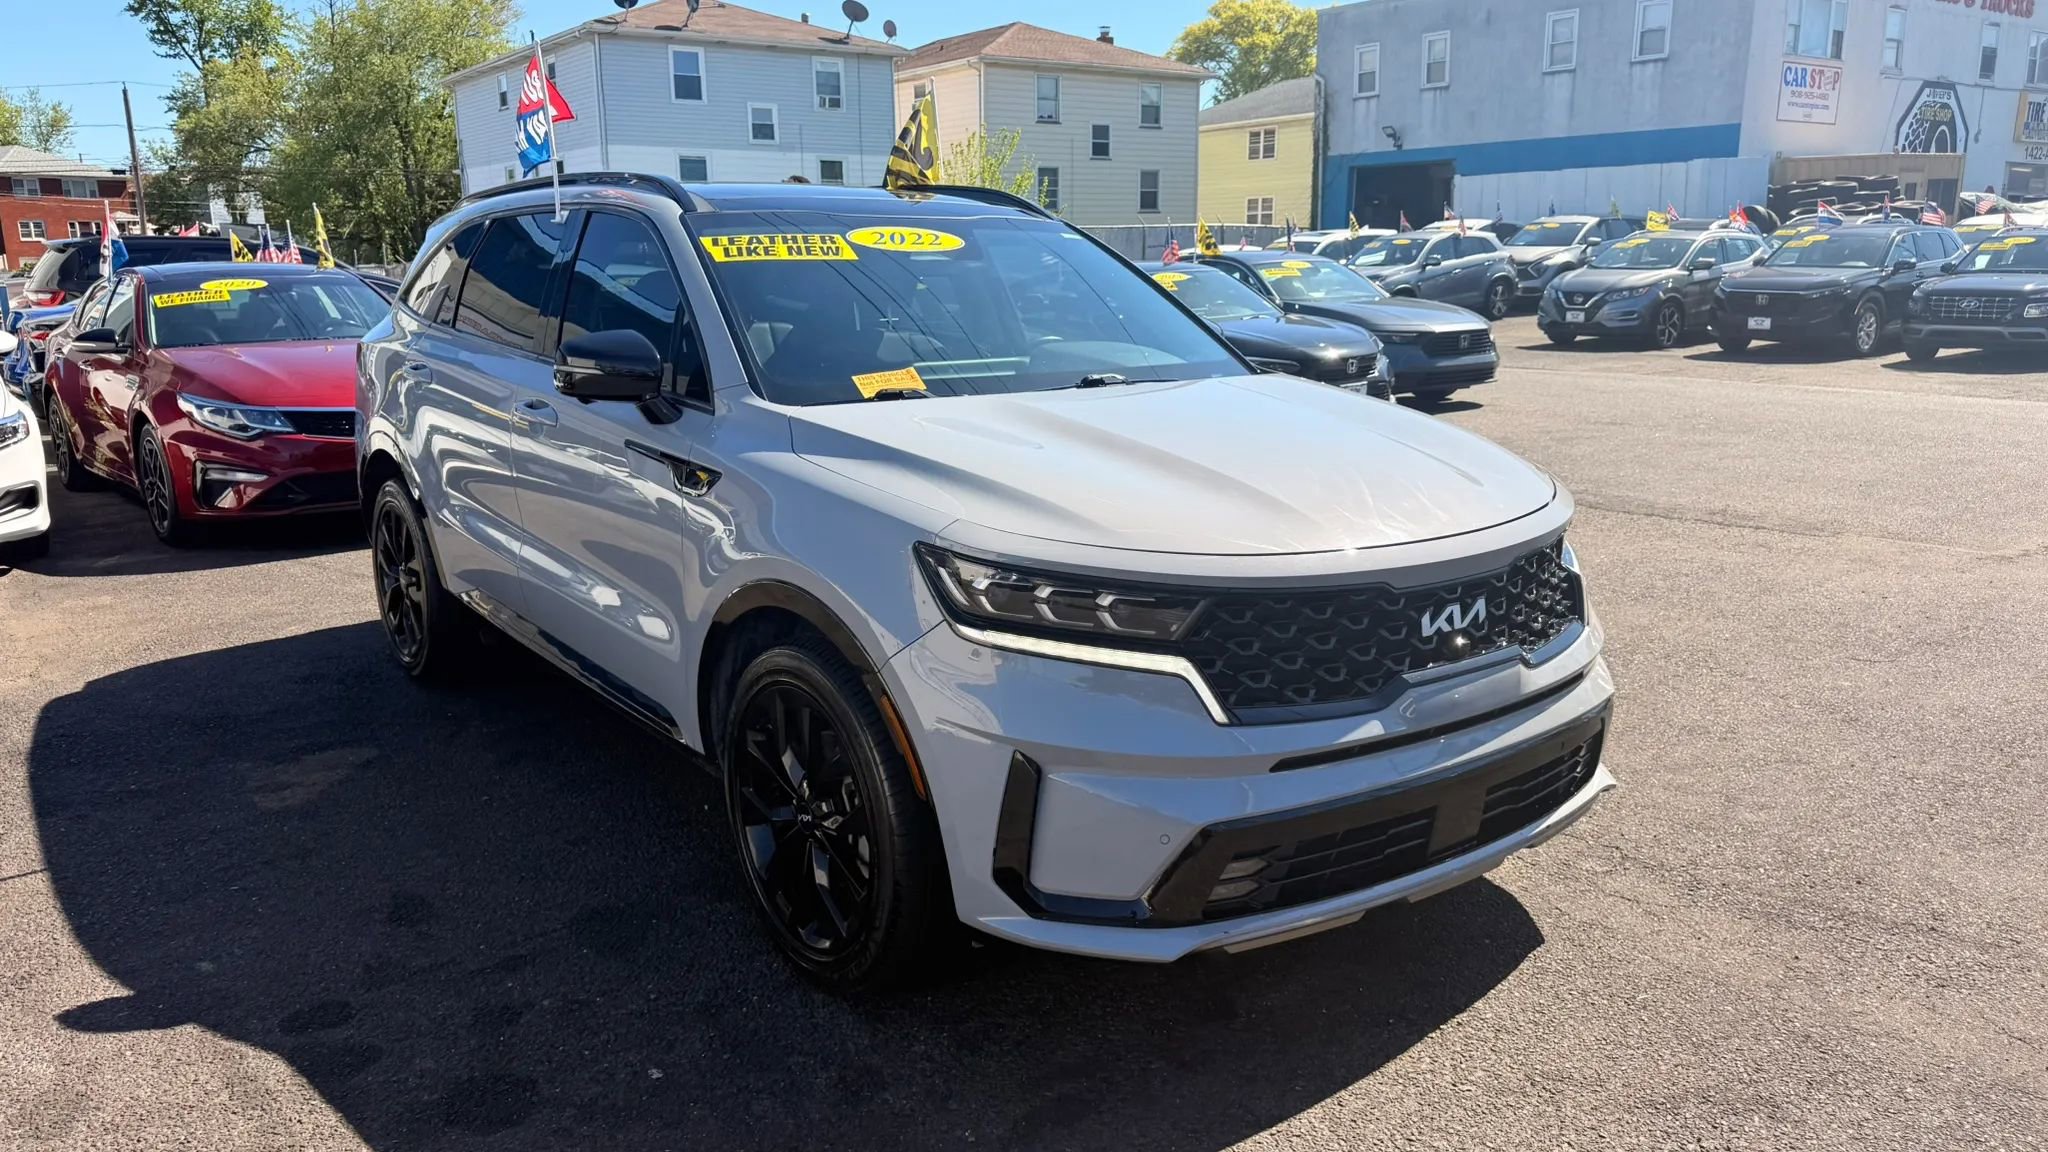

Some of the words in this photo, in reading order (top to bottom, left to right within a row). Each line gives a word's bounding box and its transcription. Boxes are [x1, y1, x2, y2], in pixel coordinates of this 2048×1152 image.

[1783, 66, 1808, 88] CAR
[1935, 108, 1952, 122] SHOP
[711, 235, 838, 247] LEATHER
[870, 231, 943, 246] 2022
[723, 246, 778, 258] LIKE
[786, 245, 841, 257] NEW
[215, 280, 257, 288] 2020
[159, 289, 224, 300] LEATHER
[179, 294, 225, 303] FINANCE
